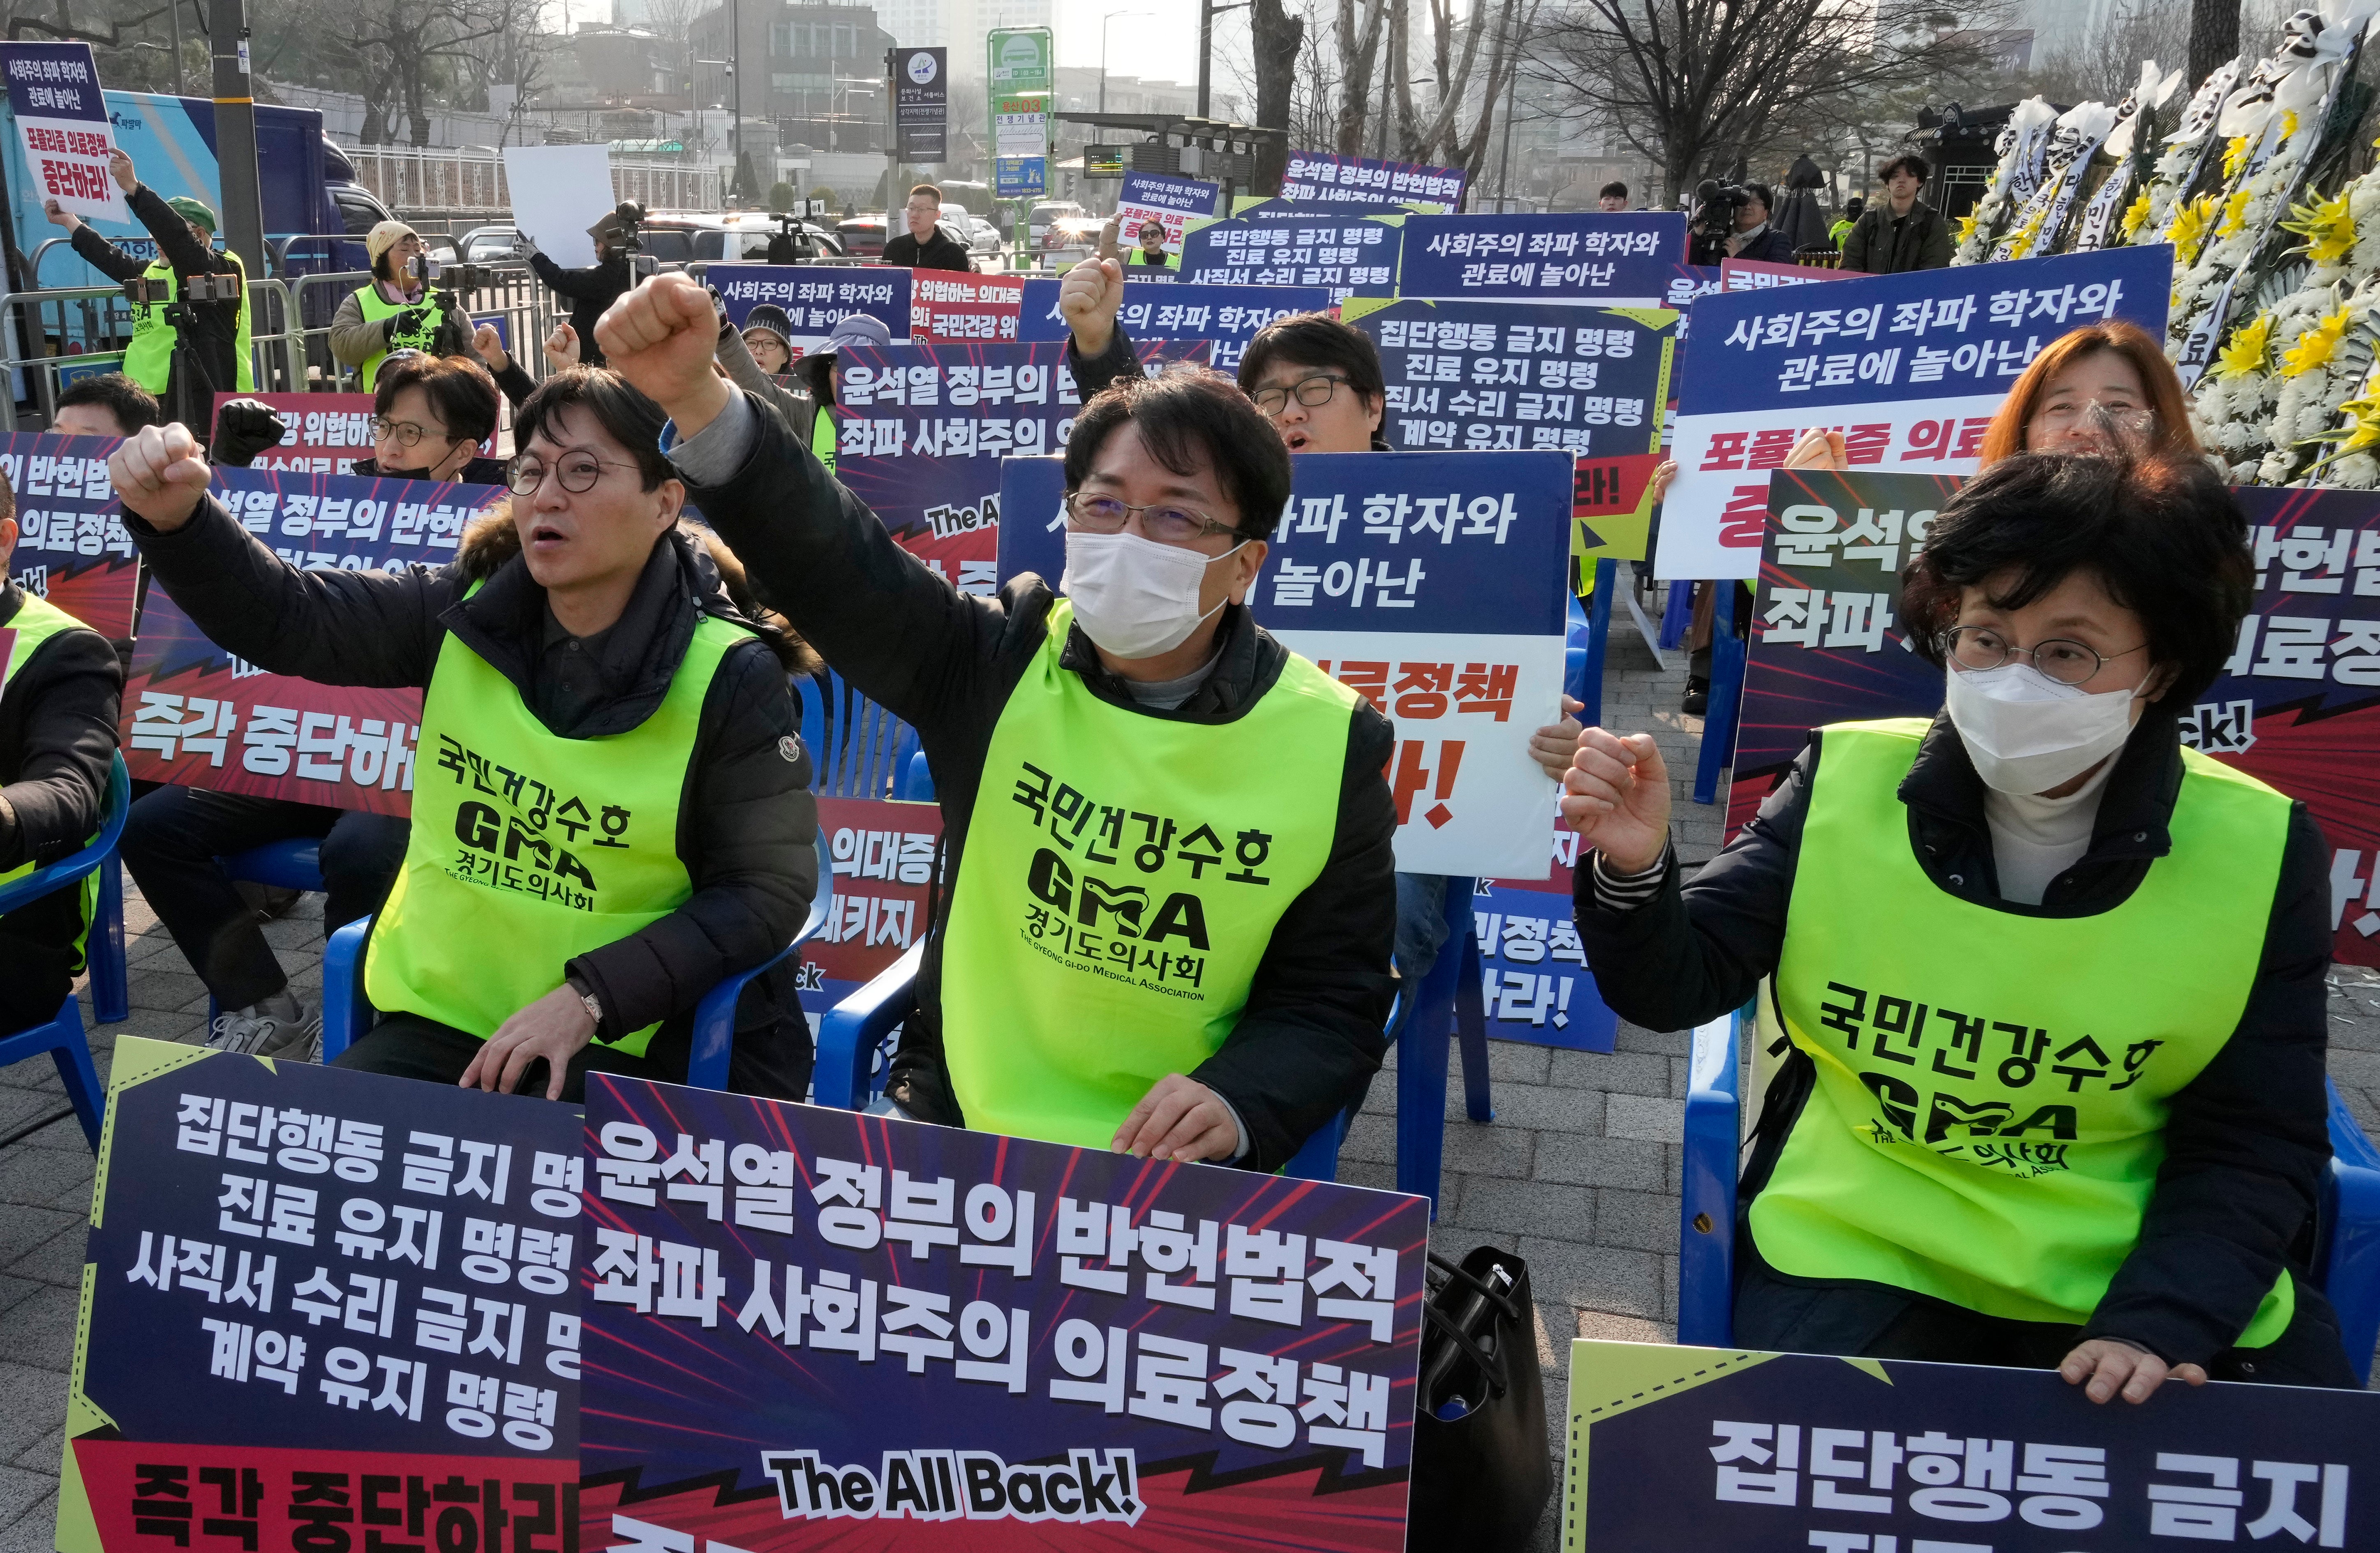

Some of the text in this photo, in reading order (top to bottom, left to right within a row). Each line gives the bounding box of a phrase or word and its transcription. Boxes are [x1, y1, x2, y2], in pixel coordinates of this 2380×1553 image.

[9, 59, 88, 83] 사회주의 좌파 학자와
[28, 87, 82, 111] 관료에 놀아난
[1002, 99, 1041, 113] 용산 03
[26, 127, 109, 159] 포퓰리즘 의료정책
[41, 159, 111, 203] 중단하라!
[1131, 179, 1210, 199] 사회주의 좌파 학자와
[1141, 192, 1193, 208] 관료에 놀아난
[1287, 159, 1460, 198] 윤석열 정부의 반헌법적
[1209, 227, 1384, 247] 집단행동 금지 명령
[1226, 247, 1359, 265] 진료 유지 명령
[1426, 231, 1660, 258] 사회주의 좌파 학자와
[723, 281, 795, 302] 사회주의
[797, 282, 835, 303] 좌파
[839, 283, 894, 305] 학자와
[920, 280, 976, 302] 위협하는
[1190, 267, 1390, 285] 사직서 수리 금지 명령
[1461, 262, 1615, 287] 관료에 놀아난
[932, 314, 998, 338] 국민건강
[1156, 305, 1211, 331] 좌파
[1724, 279, 2124, 352] 사회주의 좌파 학자와
[1379, 320, 1635, 358] 집단행동 금지 명령
[842, 365, 939, 406] 윤석열
[946, 365, 1048, 406] 정부의
[1405, 354, 1599, 390] 진료 유지 명령
[1778, 336, 2042, 392] 관료에 놀아난
[1384, 385, 1644, 427] 직서 수리 금지 명령
[303, 412, 376, 448] 위협하
[841, 418, 906, 458] 좌파
[911, 418, 1047, 458] 사회주의
[1397, 419, 1591, 457] 계약 유지 명령
[1699, 423, 1891, 471] 포퓰즘
[27, 455, 118, 500] 반헌법
[18, 509, 133, 558] 의료정책
[281, 494, 387, 542] 정부의
[390, 501, 492, 548] 반헌
[926, 504, 978, 538] The
[1361, 493, 1518, 545] 학자와
[1272, 556, 1426, 608] 놀아난
[1762, 587, 1894, 653] 좌파
[1317, 659, 1519, 722] 료정책
[131, 690, 238, 768] 즉각
[455, 801, 597, 891] GMA
[1012, 761, 1273, 886] 국민건강수호
[832, 827, 946, 885] 의대증
[455, 849, 593, 912] 경기도의사회
[1027, 847, 1211, 952] GMA
[1024, 903, 1205, 988] 경기도의사회
[1033, 941, 1063, 964] GYEONG
[1065, 960, 1090, 973] GI-DO
[1858, 1071, 2077, 1144] GMA
[176, 1093, 384, 1184] 집단행동
[401, 1130, 513, 1205] 금지
[217, 1172, 574, 1296] 진료 유지 명령
[595, 1121, 1397, 1344] 윤석열 정부의 반헌법적
[126, 1230, 527, 1366] 사직서 수리 금지
[591, 1228, 1390, 1470] 좌파 사회주의 의료정책
[201, 1317, 558, 1451] 계약 유지 명령
[765, 1452, 1141, 1522] The All Back!
[1708, 1419, 2350, 1549] 집단행동 금지
[132, 1463, 264, 1553] 즉각
